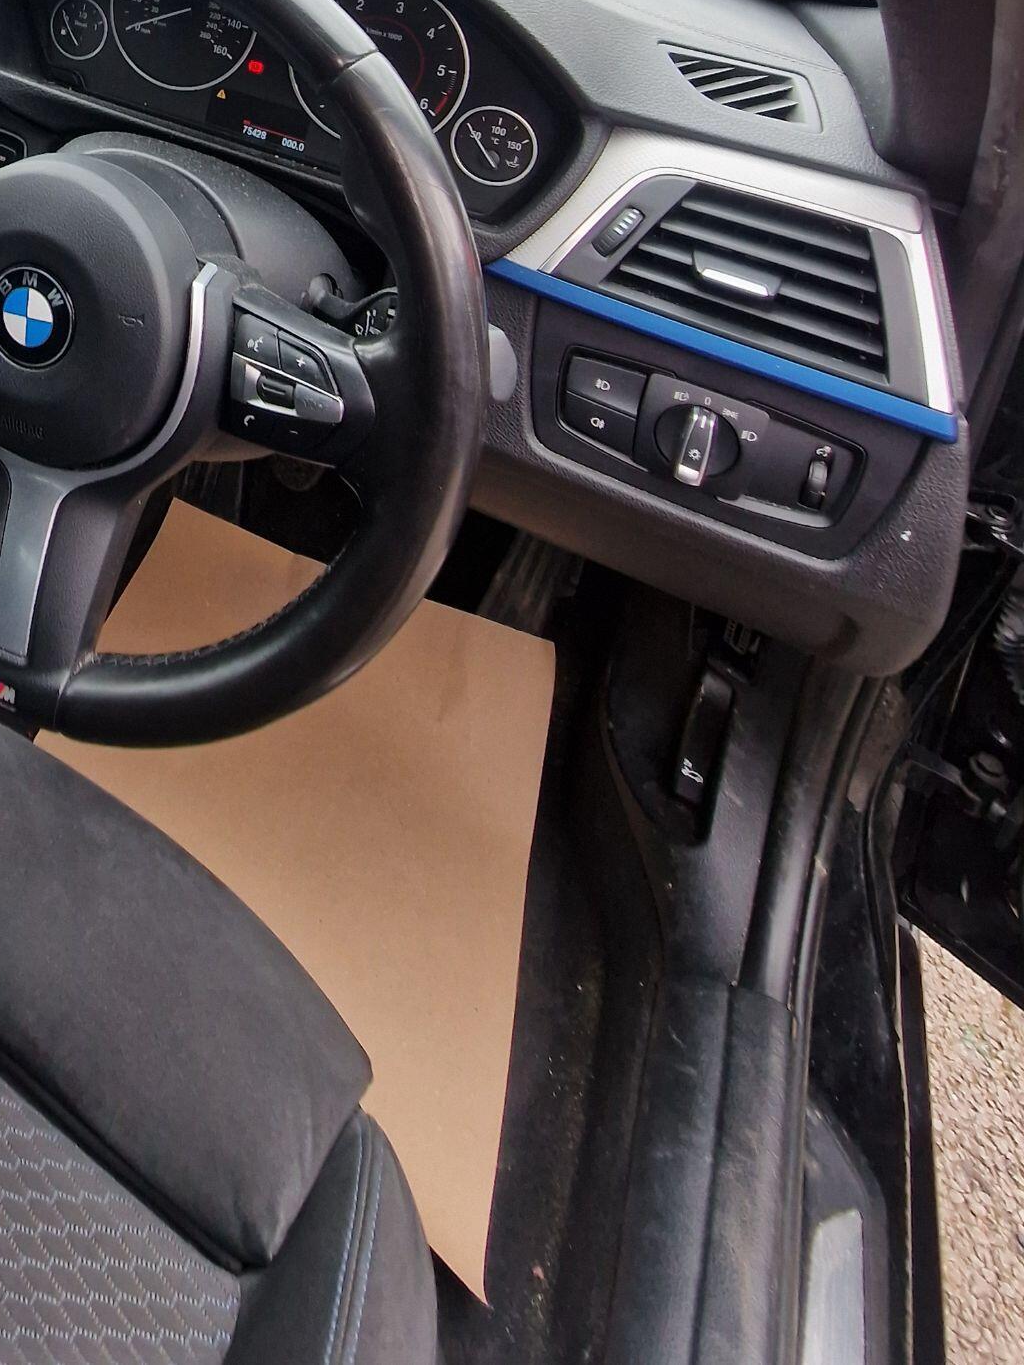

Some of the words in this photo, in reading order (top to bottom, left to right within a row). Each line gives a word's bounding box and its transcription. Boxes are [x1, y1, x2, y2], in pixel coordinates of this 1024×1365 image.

[356, 0, 365, 11] 2
[396, 1, 405, 14] 3
[227, 18, 242, 30] 140
[426, 27, 436, 40] 4
[213, 44, 228, 56] 160
[436, 64, 447, 77] 5
[419, 98, 429, 110] 6
[491, 125, 507, 137] 100
[242, 125, 267, 140] 75428
[281, 137, 305, 152] 000.0
[507, 140, 522, 151] 150
